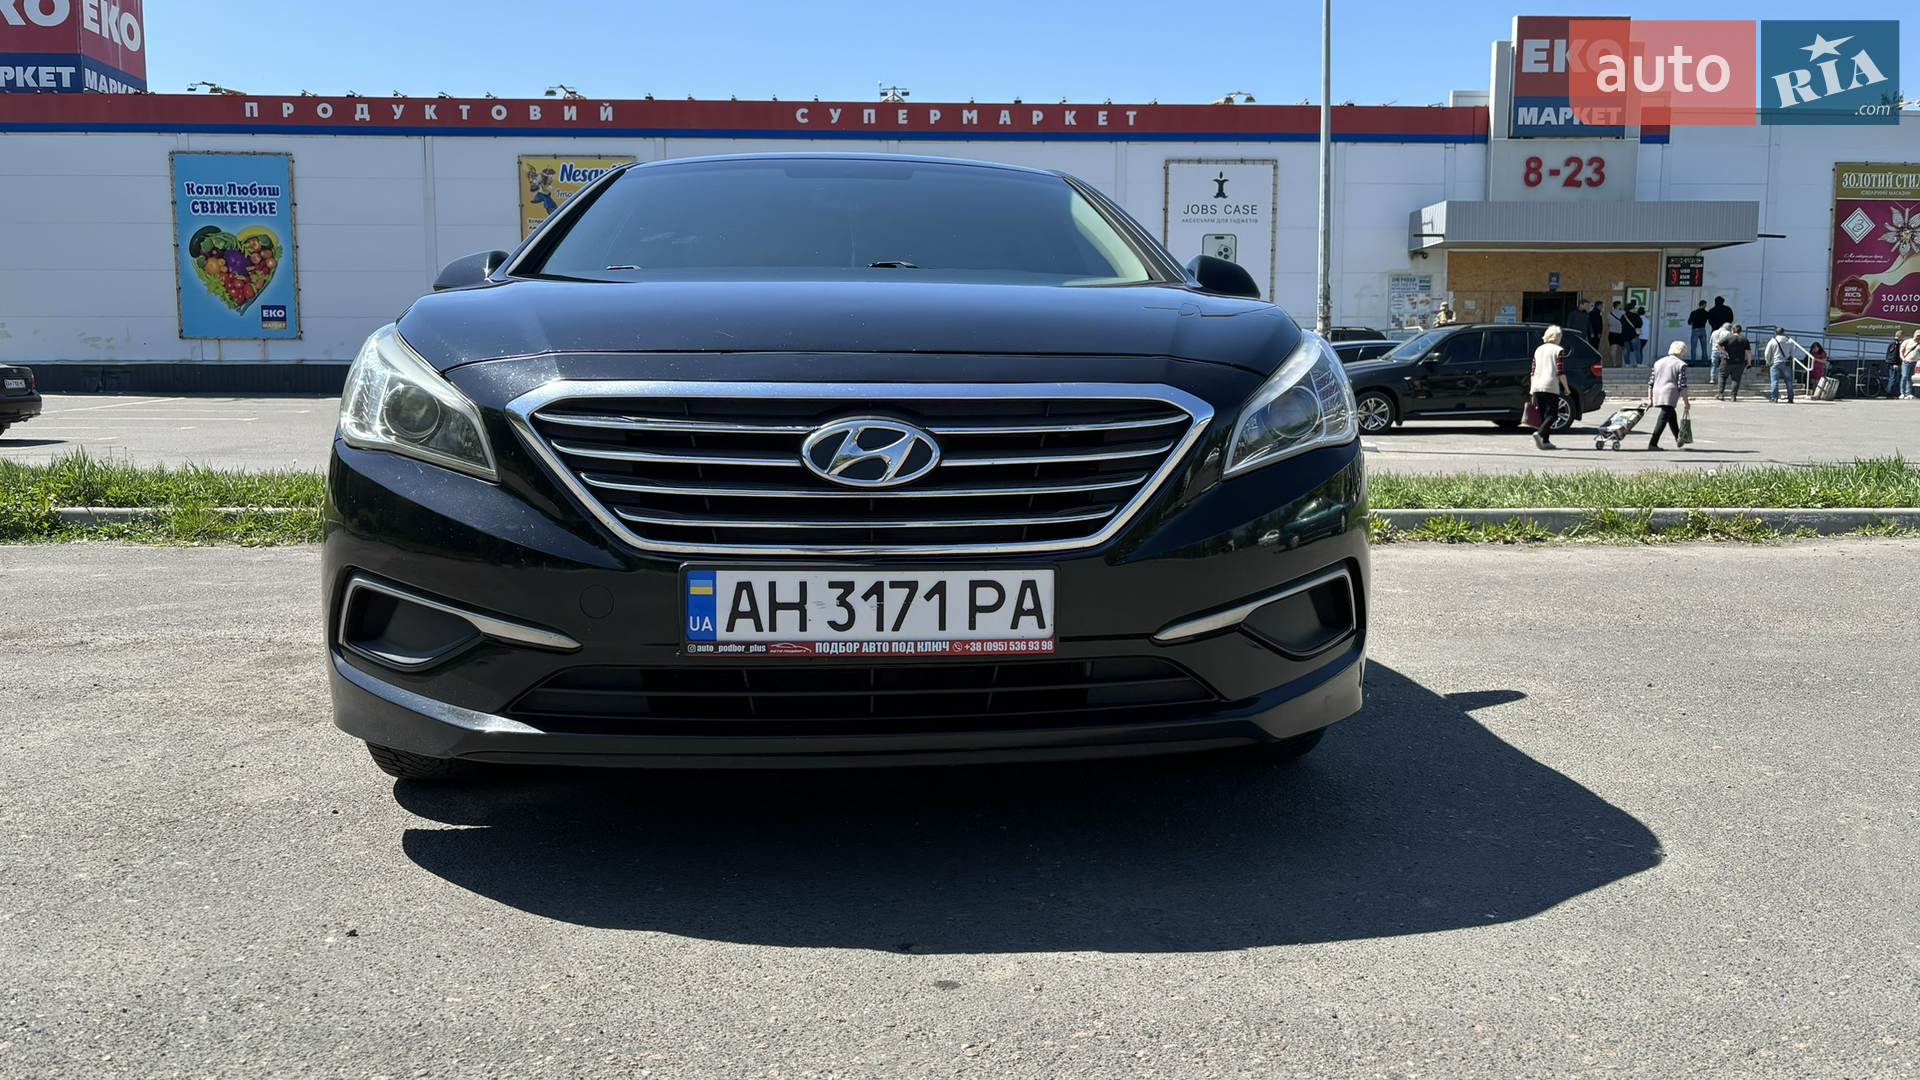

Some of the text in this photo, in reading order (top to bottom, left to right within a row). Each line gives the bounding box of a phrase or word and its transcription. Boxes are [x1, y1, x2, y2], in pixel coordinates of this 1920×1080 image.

[83, 0, 141, 52] ЕКО
[1521, 38, 1625, 73] ЕКО
[245, 102, 1137, 125] ПРОДУКТОВИЙ СУПЕРМАРКЕТ
[1517, 107, 1622, 126] МАРКЕТ
[1842, 172, 1893, 188] ЗОЛОТИЙ
[184, 182, 280, 197] Коли Любиш
[1183, 204, 1258, 215] JOBS CASE
[1881, 294, 1920, 302] ЗОЛОТО
[262, 309, 285, 318] ЕКО
[725, 579, 1046, 633] AH 3171 PA
[689, 616, 713, 632] UA
[696, 644, 766, 654] auto_podbor_plus
[815, 641, 950, 655] ПОДБОР АВТО ПОД КЛЮЧ
[964, 640, 1053, 652] +38 (095) 536 93 98
